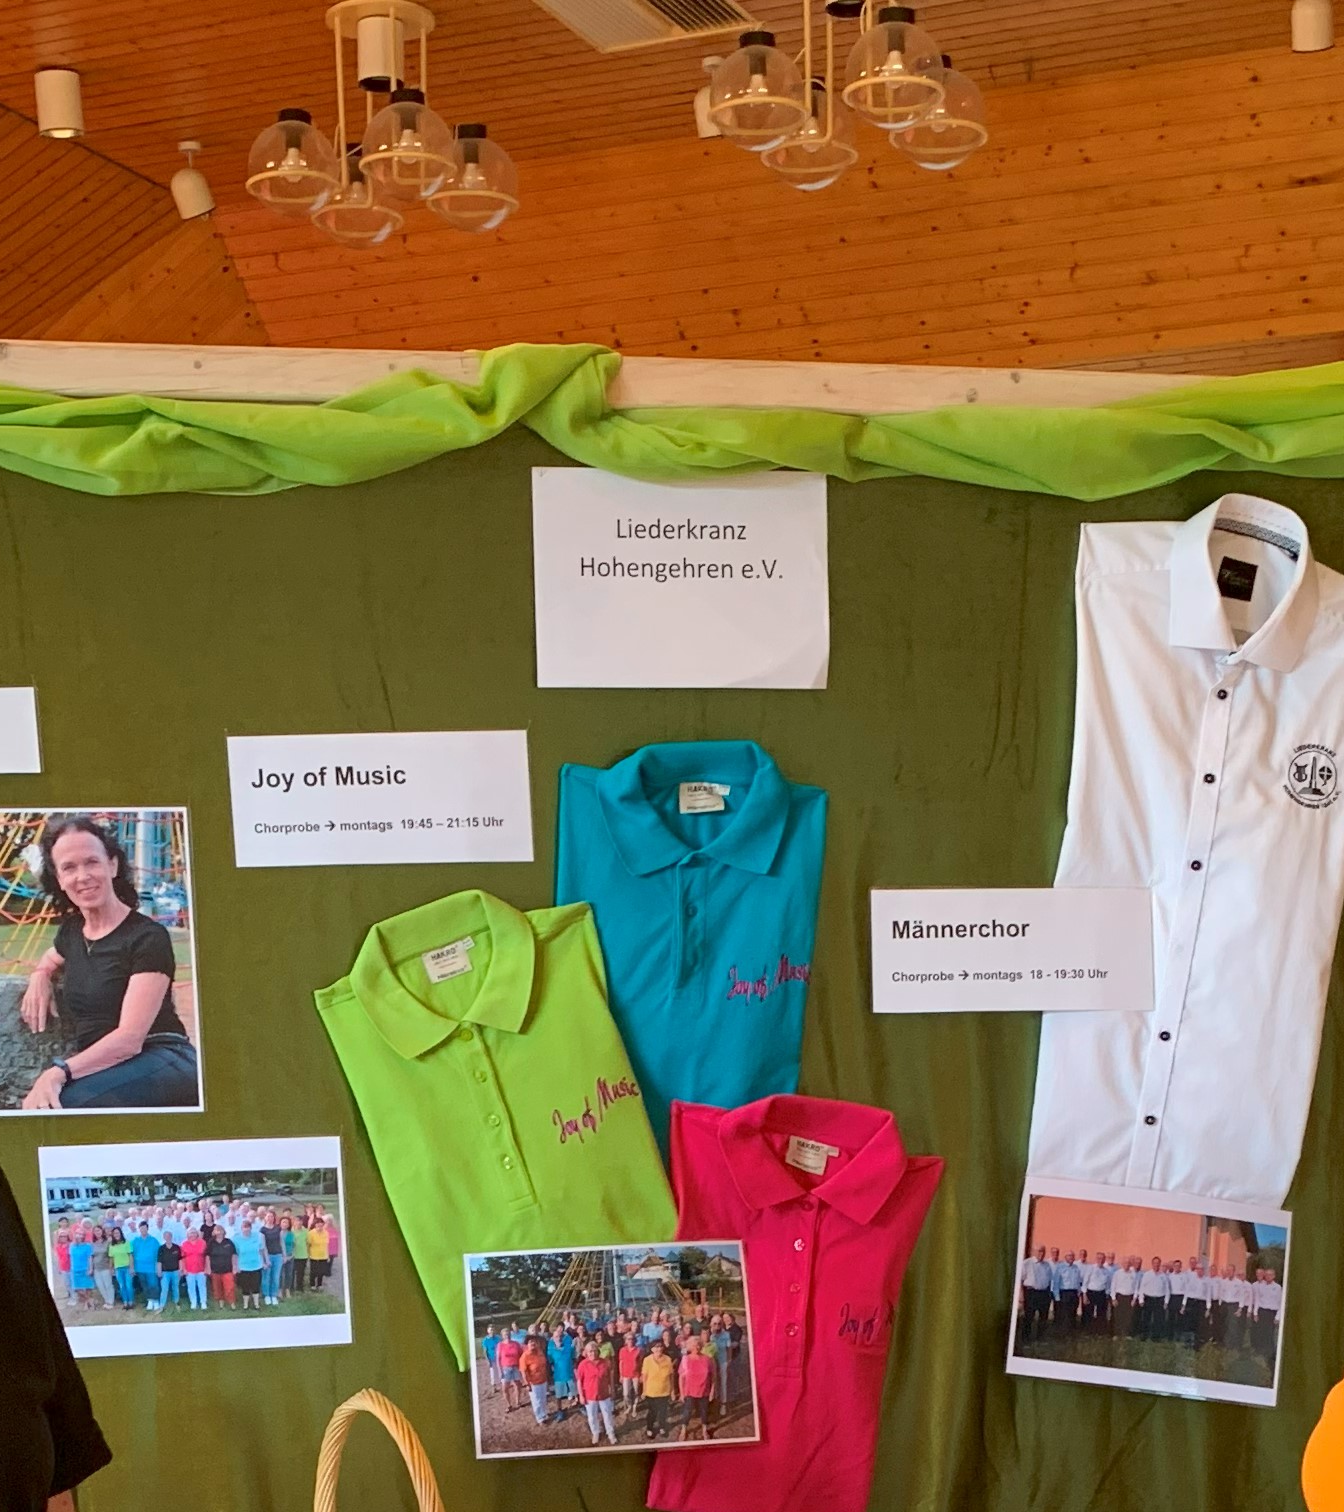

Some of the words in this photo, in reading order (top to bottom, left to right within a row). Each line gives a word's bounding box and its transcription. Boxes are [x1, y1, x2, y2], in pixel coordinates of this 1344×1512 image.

[616, 517, 747, 541] Liederkranz
[580, 555, 734, 583] Hohengehren
[741, 559, 784, 580] e.V.
[250, 767, 296, 794] Joy
[303, 765, 328, 788] of
[334, 764, 407, 787] Music
[253, 822, 321, 835] Chorprobe
[340, 820, 394, 834] montags
[400, 818, 434, 830] 19:45
[446, 816, 480, 829] 21:15
[482, 815, 505, 828] Uhr
[891, 918, 1031, 940] Männerchor
[891, 971, 955, 984] Chorprobe
[972, 970, 1024, 983] montags
[1030, 968, 1044, 980] 18
[1054, 968, 1085, 980] 19:30
[1087, 968, 1109, 980] Uhr
[551, 1109, 584, 1144] Joy
